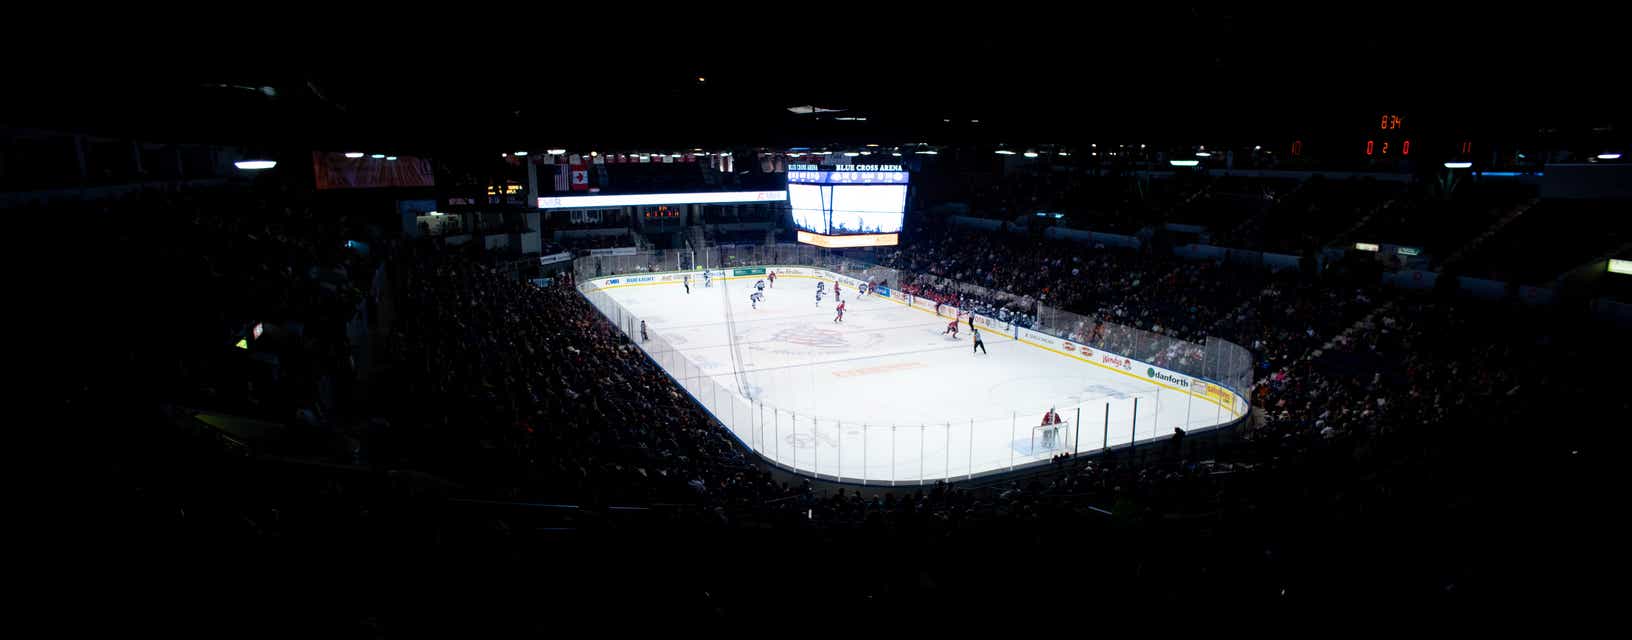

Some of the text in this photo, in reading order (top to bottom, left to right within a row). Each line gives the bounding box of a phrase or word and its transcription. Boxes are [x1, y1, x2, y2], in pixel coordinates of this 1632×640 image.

[1367, 140, 1374, 155] 0
[1382, 142, 1388, 154] 2
[1403, 140, 1410, 155] 0
[1155, 372, 1189, 387] danforth
